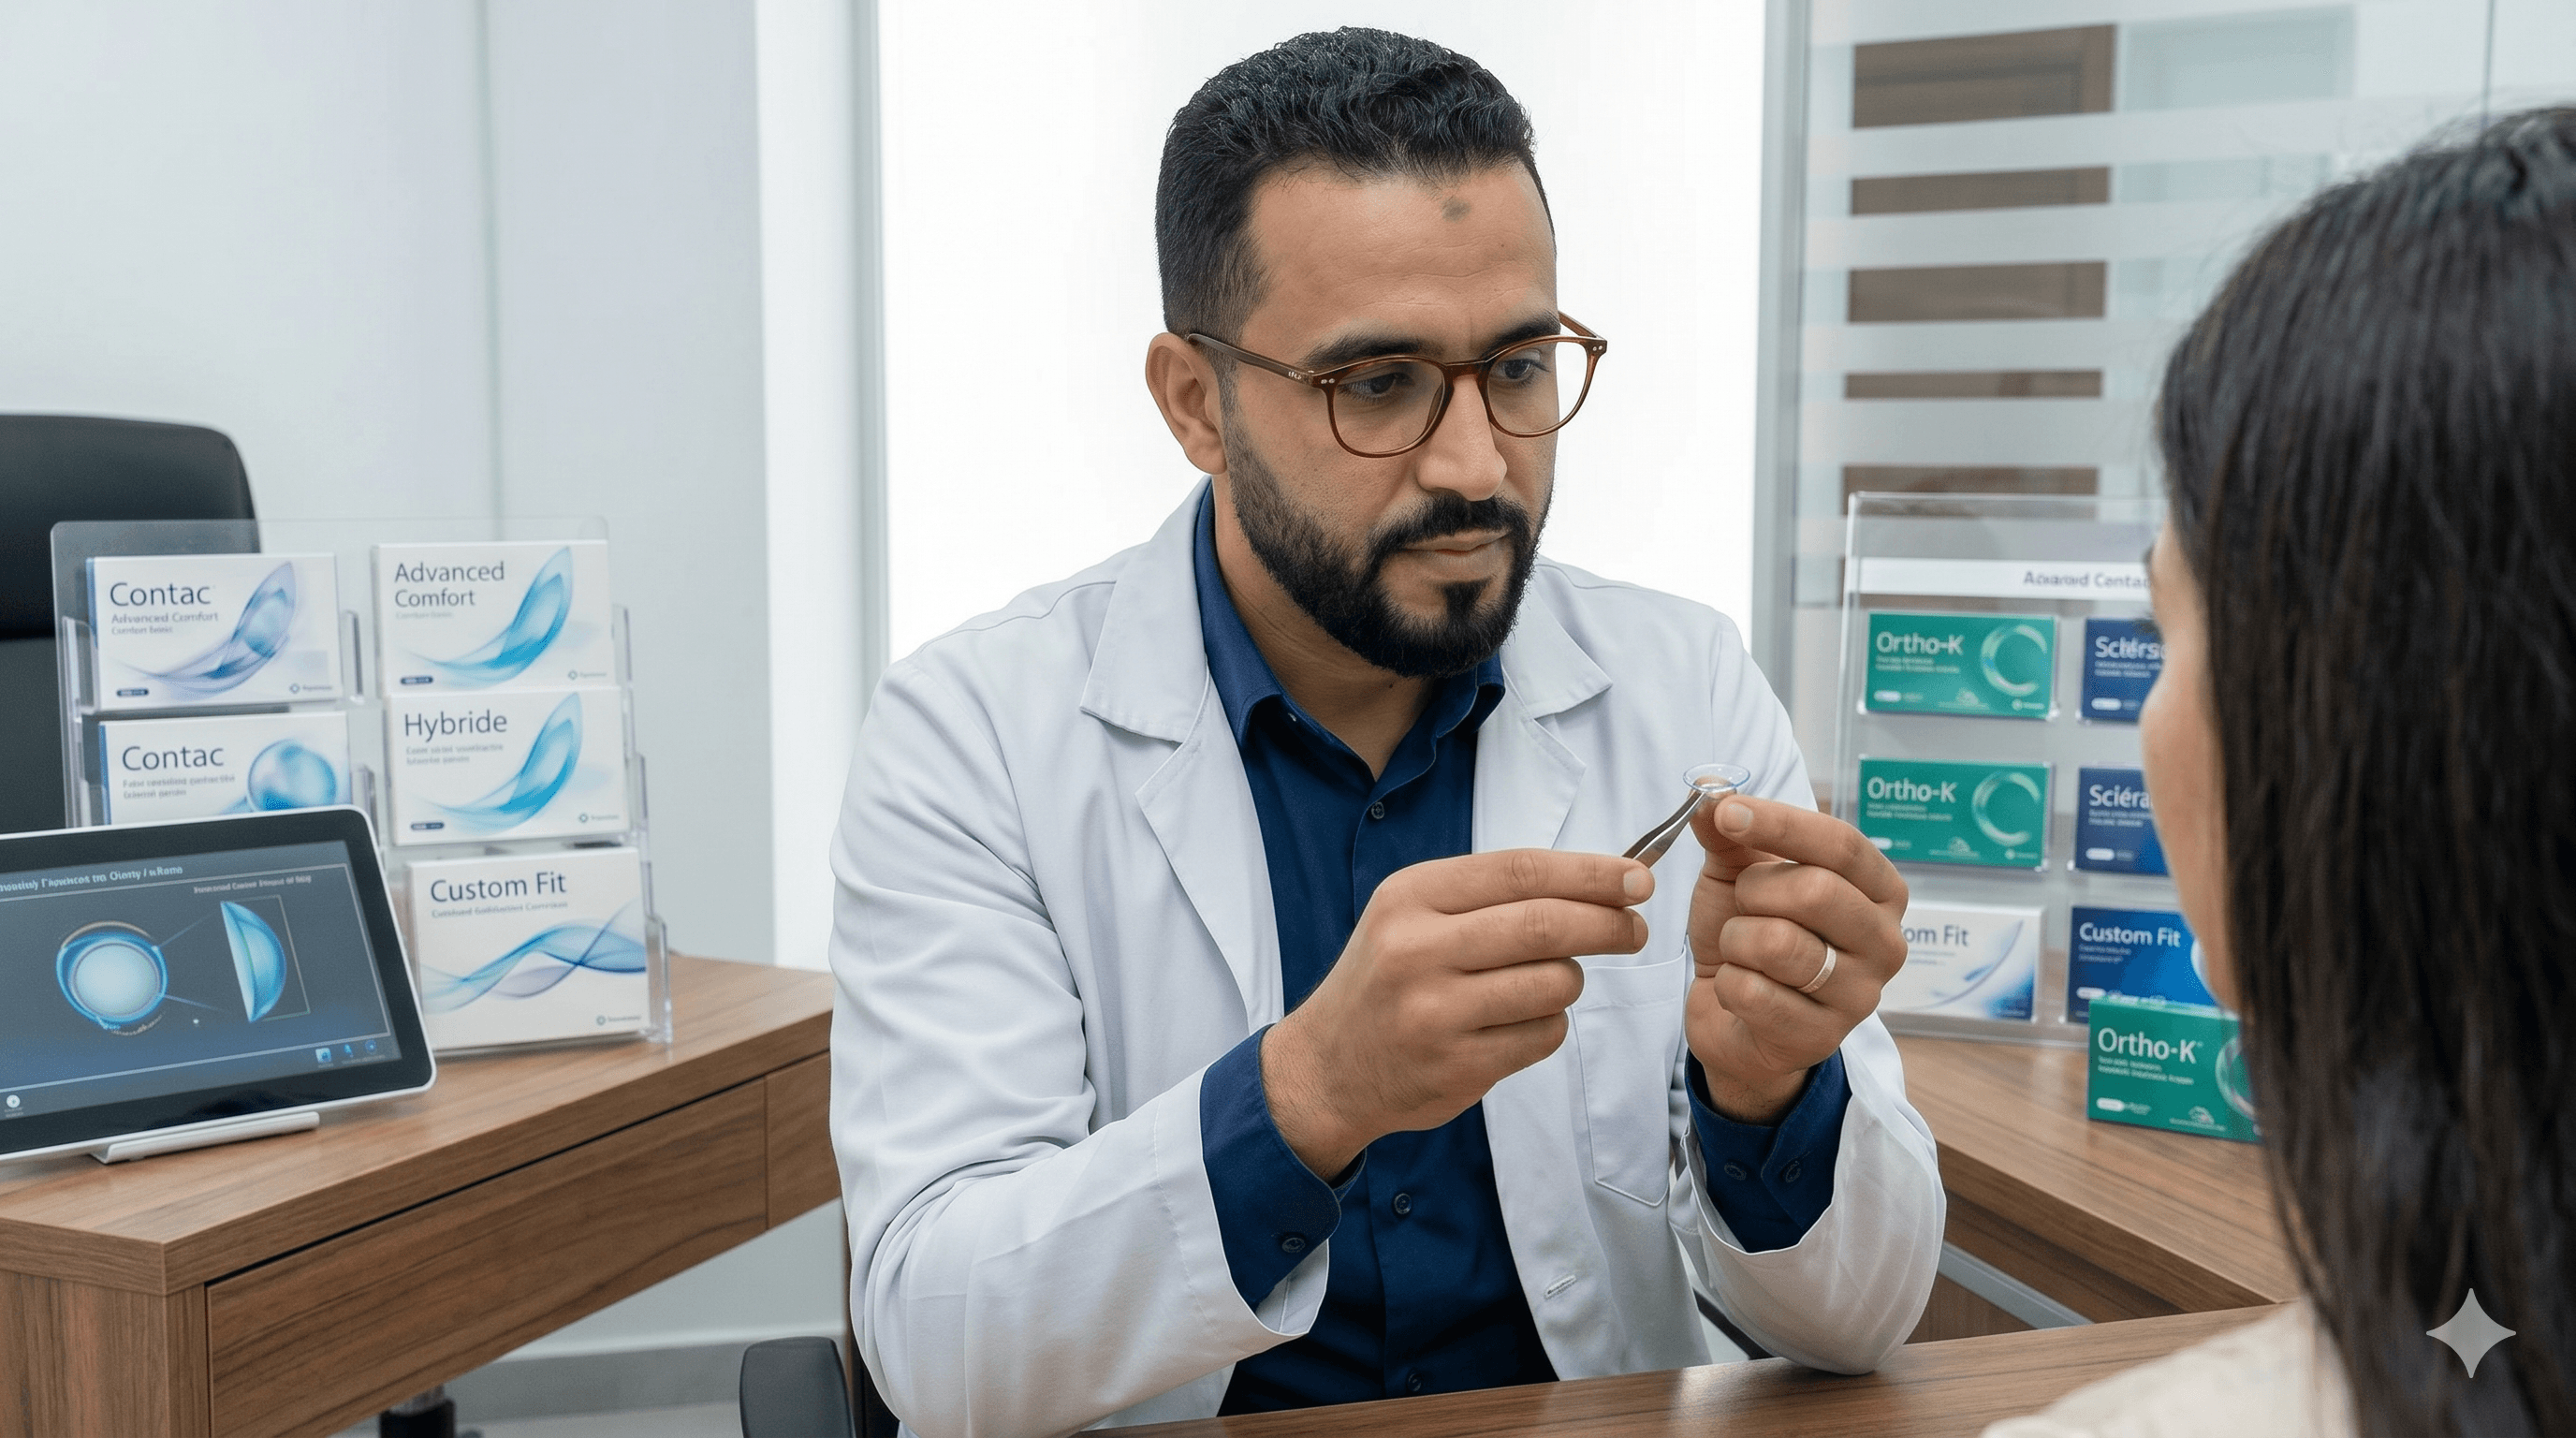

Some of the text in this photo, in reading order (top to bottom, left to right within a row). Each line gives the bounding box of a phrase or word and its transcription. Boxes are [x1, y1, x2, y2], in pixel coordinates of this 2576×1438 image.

[394, 560, 505, 583] Advanced
[110, 581, 212, 607] Contac
[394, 587, 476, 608] Comfort
[1876, 631, 1965, 656] Ortho-K
[404, 709, 508, 743] Hybride
[122, 745, 225, 771] Contac
[1866, 775, 1958, 804] Ortho-K
[431, 872, 567, 902] Custom Fit
[1901, 924, 1969, 946] om Fit
[2079, 921, 2182, 948] Custom Fit
[2098, 1027, 2197, 1064] Ortho-K
